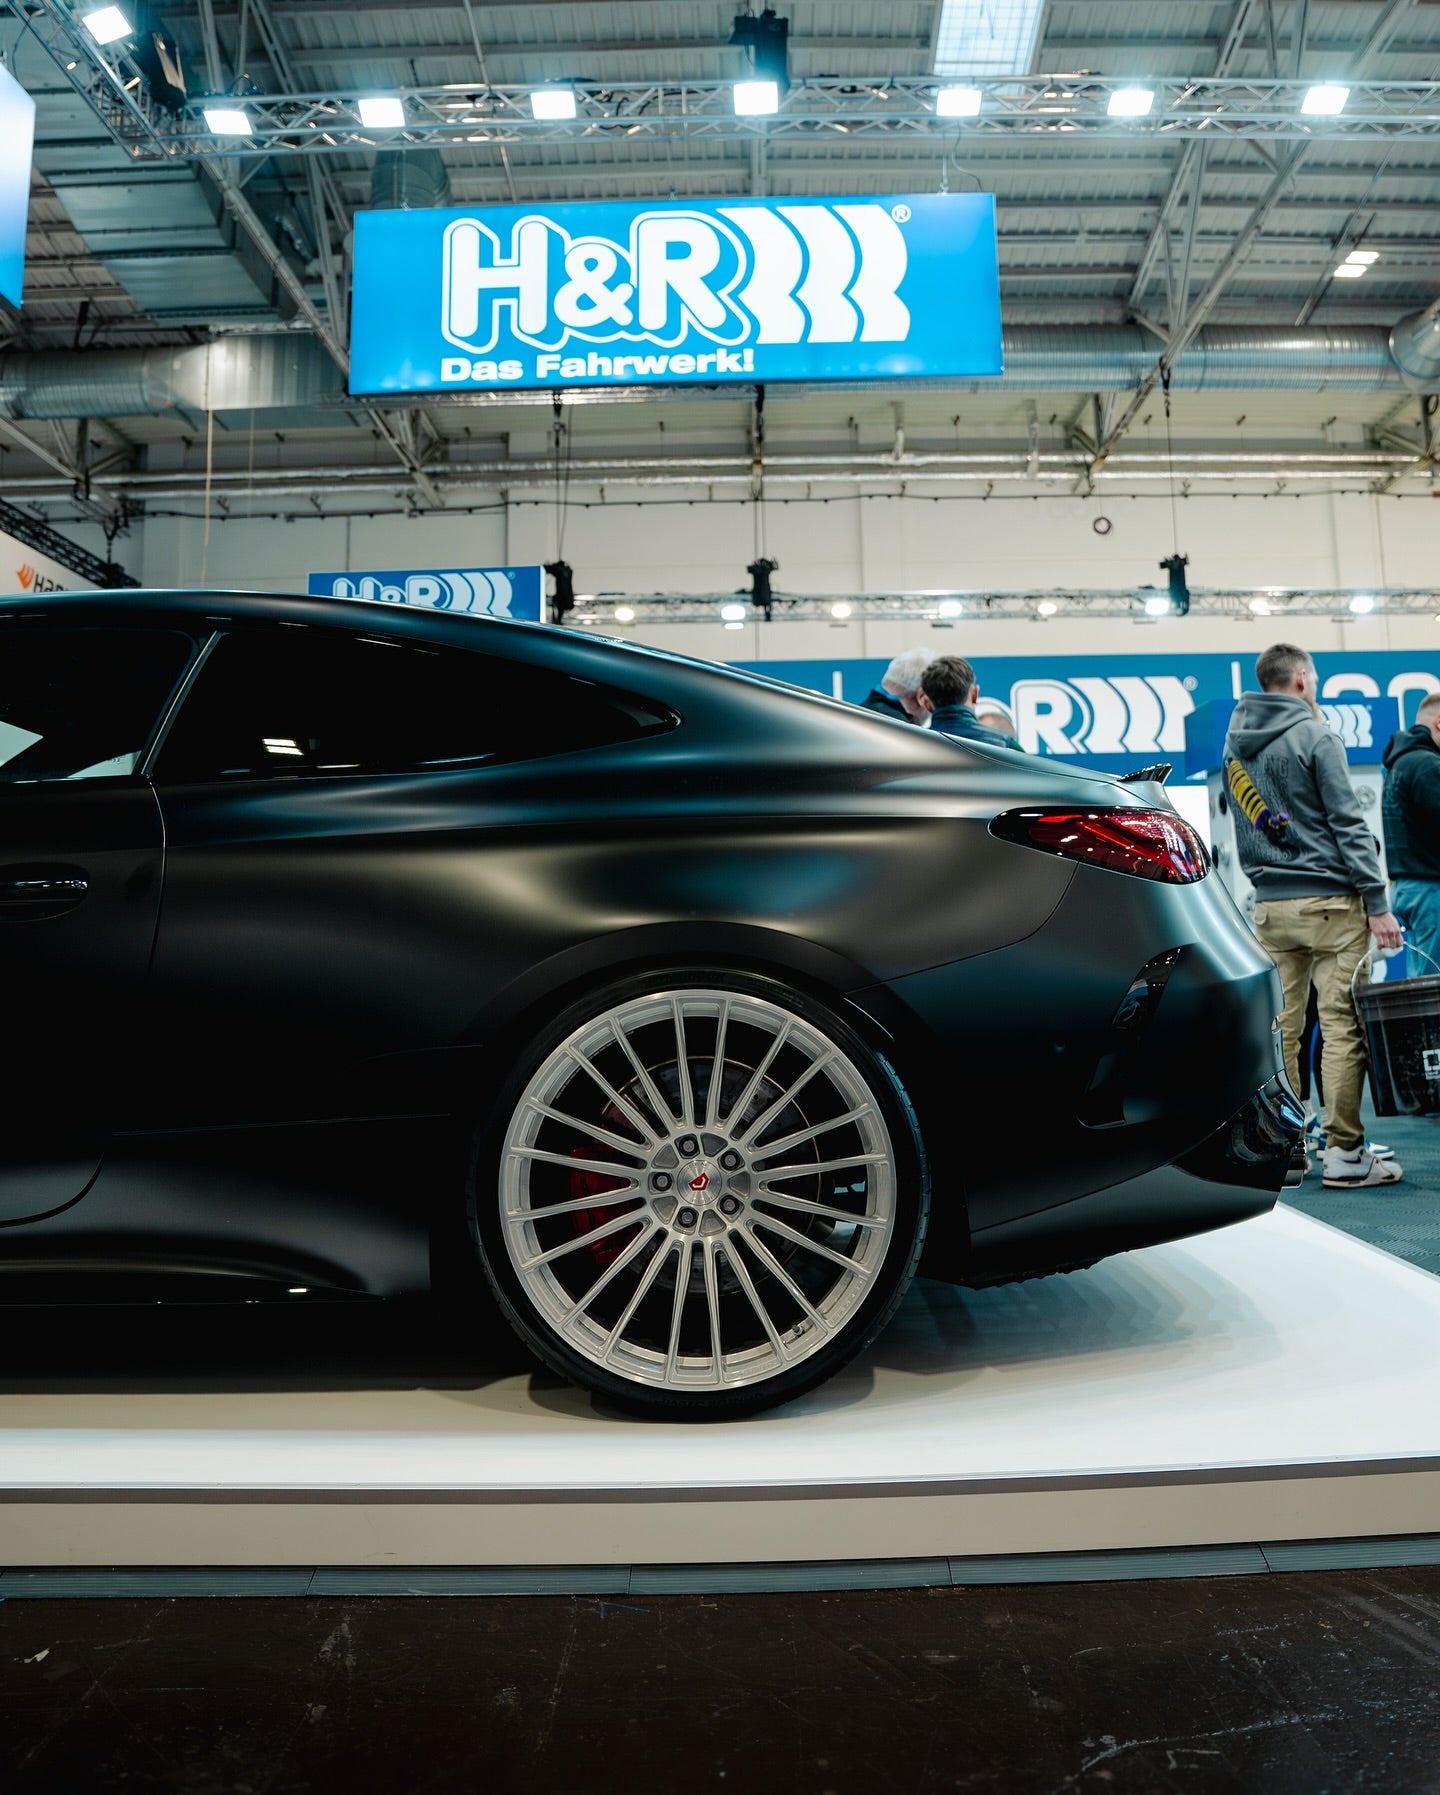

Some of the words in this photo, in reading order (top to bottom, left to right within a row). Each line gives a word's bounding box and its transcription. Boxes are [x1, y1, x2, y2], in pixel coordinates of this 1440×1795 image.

[442, 210, 751, 354] H&R
[441, 357, 523, 382] Das
[536, 349, 755, 378] Fahrwerk!
